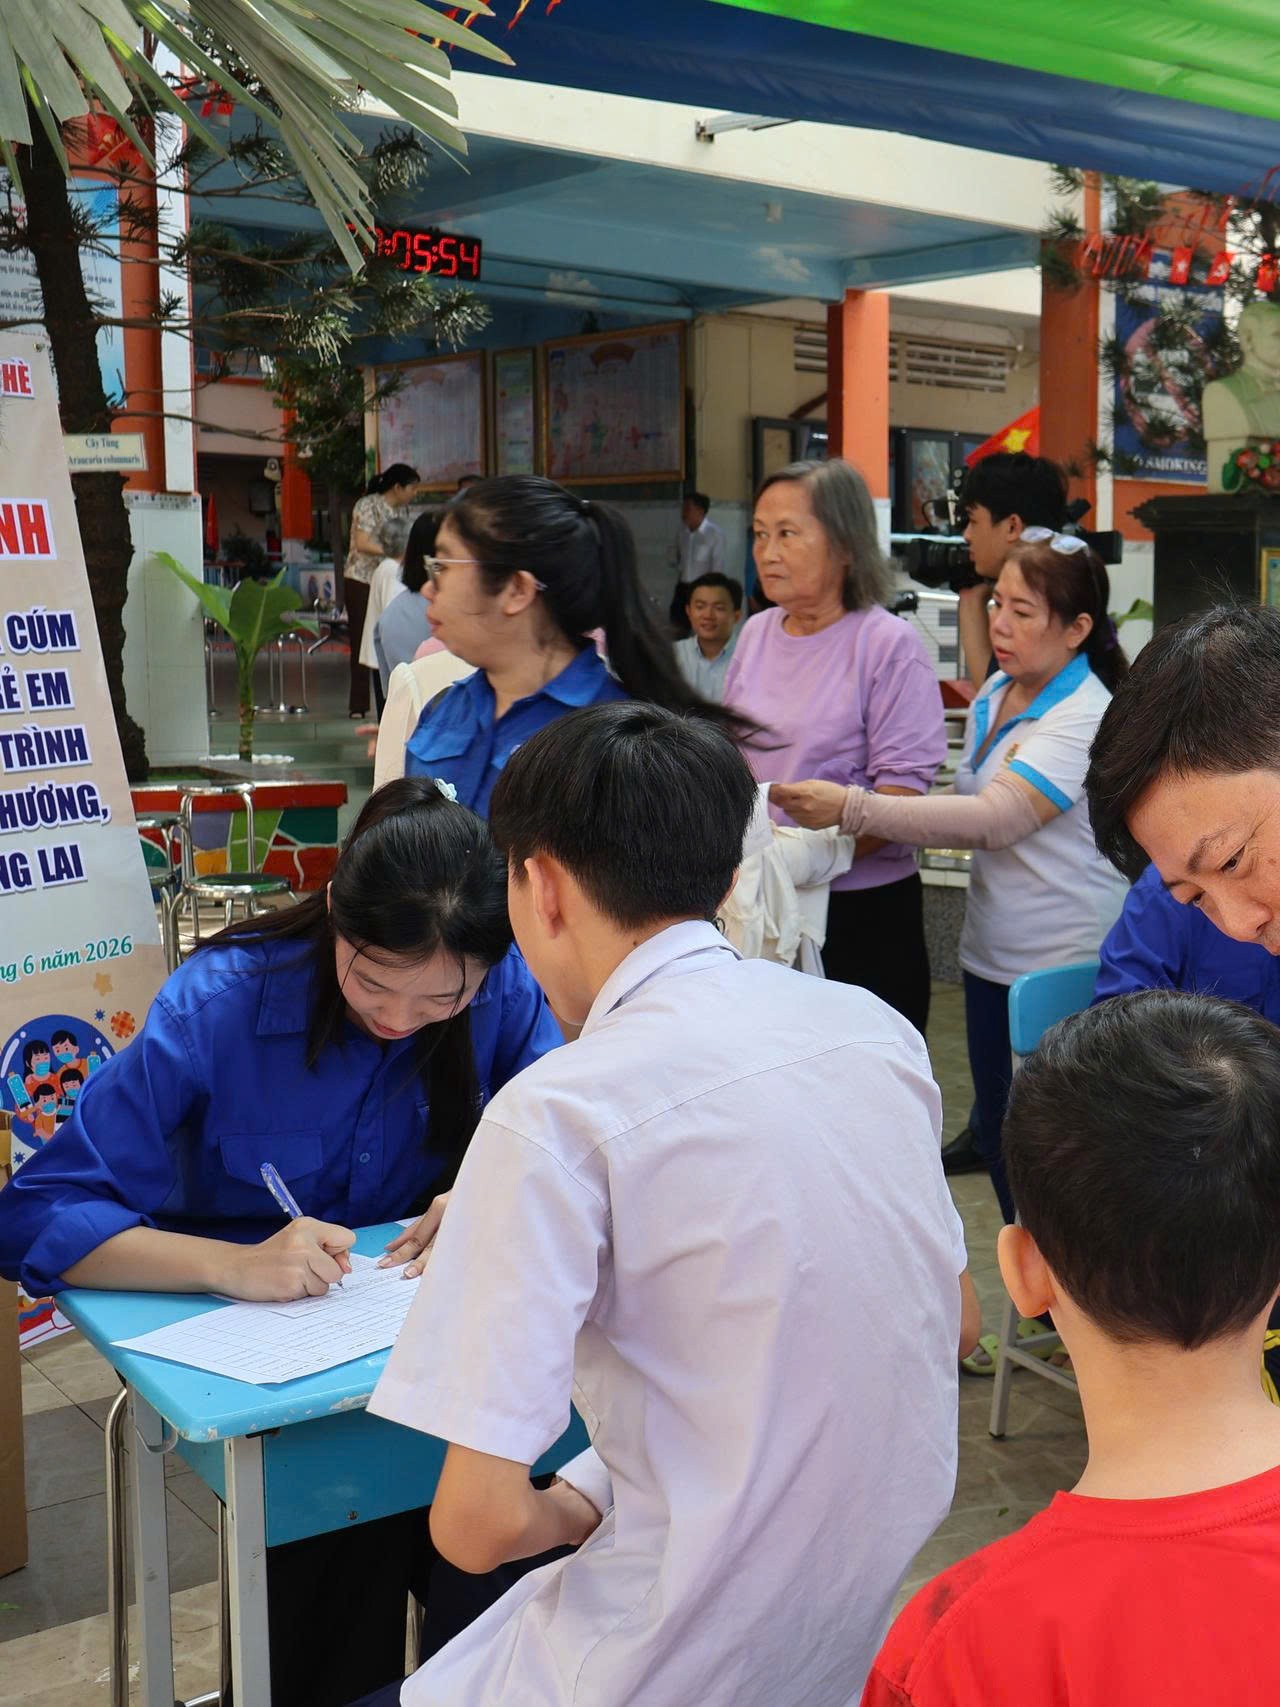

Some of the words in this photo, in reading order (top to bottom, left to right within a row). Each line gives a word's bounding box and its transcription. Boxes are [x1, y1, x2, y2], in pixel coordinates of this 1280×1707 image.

[2, 359, 32, 394] HÈ
[0, 504, 51, 554] NH
[6, 608, 77, 650] CÚM
[0, 665, 21, 709] Ẻ
[26, 671, 71, 707] EM
[0, 726, 88, 769] TRÌNH
[37, 844, 84, 883] LAI
[23, 954, 35, 975] 6
[41, 948, 81, 971] năm
[85, 935, 133, 962] 2026
